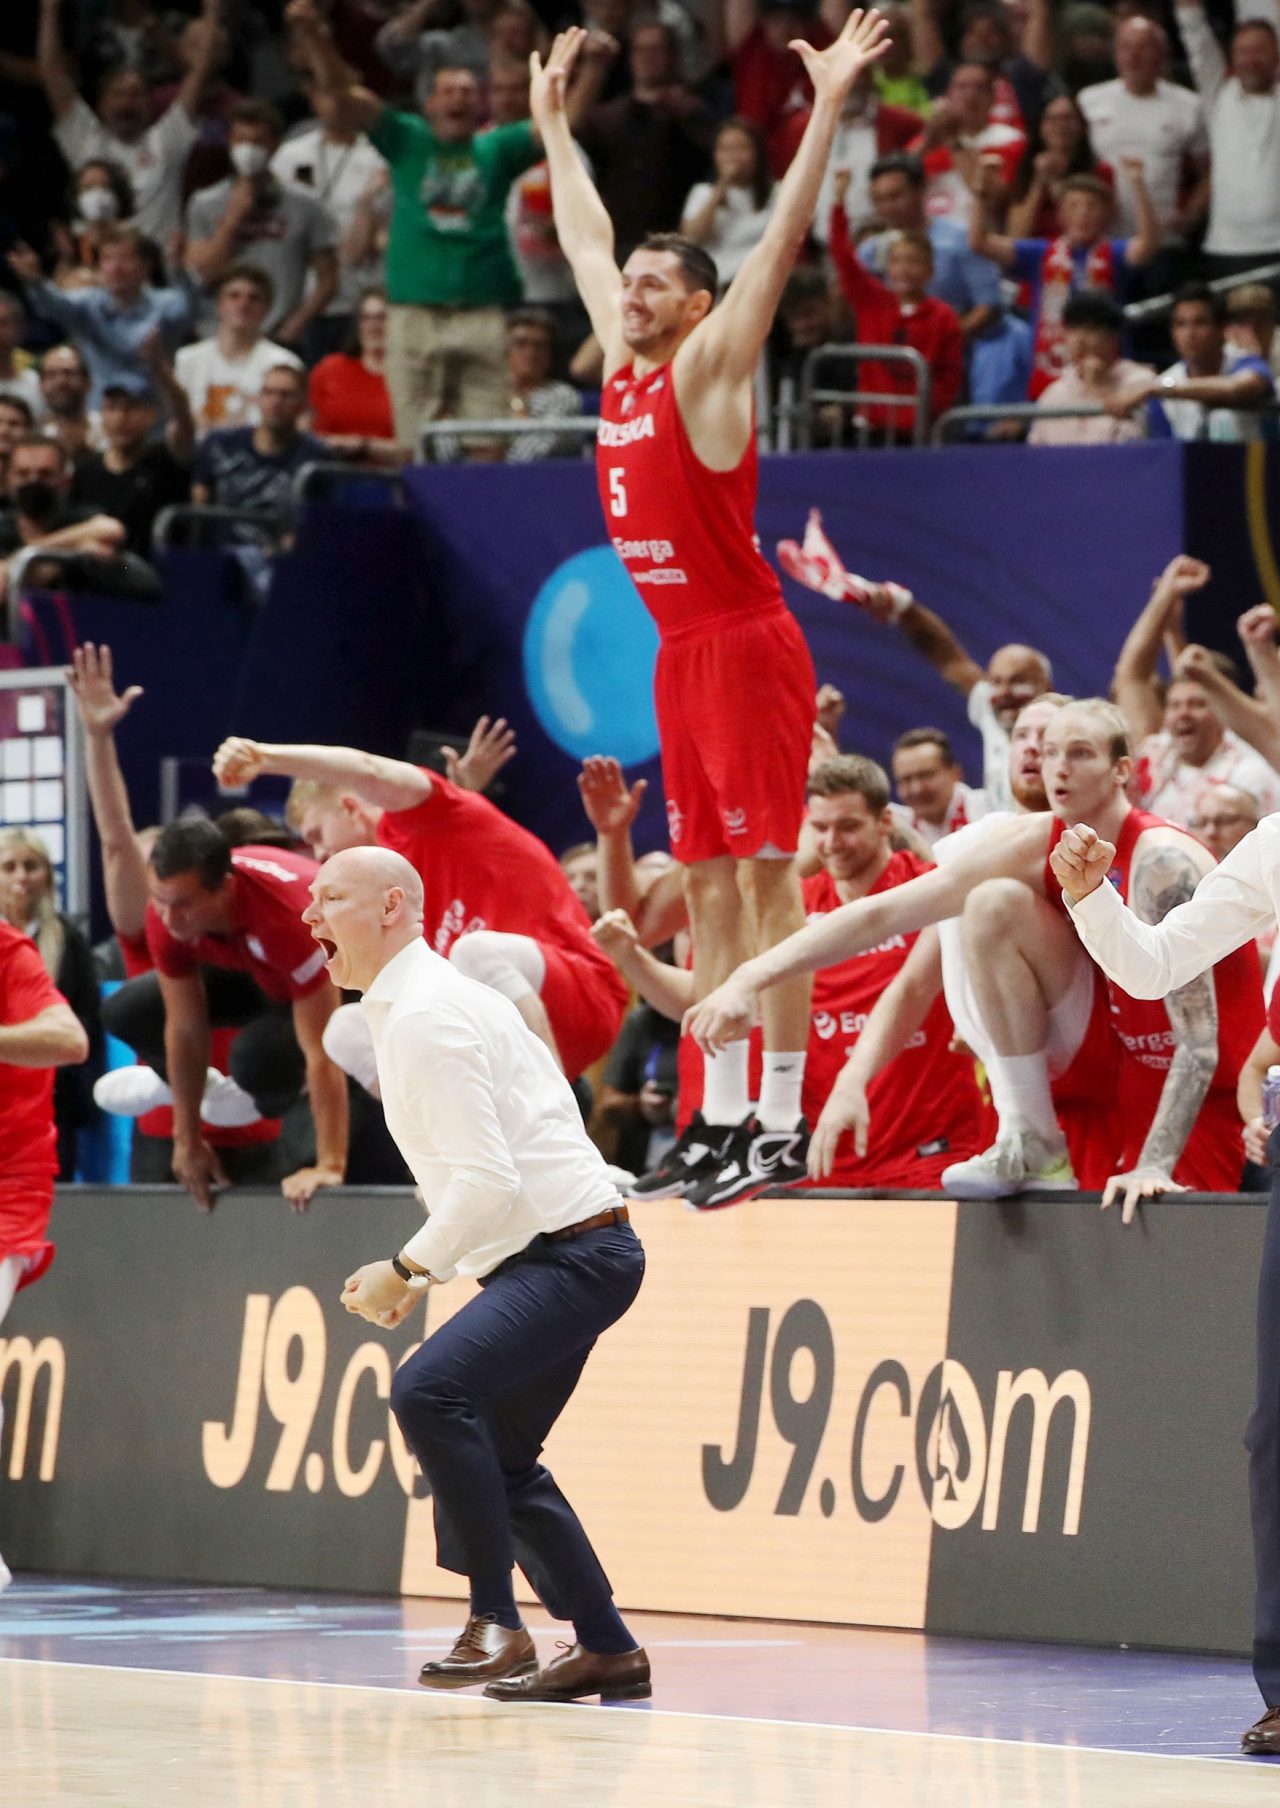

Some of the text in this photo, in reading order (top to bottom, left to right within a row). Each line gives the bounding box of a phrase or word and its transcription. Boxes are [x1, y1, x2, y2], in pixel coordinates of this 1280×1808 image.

[598, 413, 655, 447] OLSKA
[609, 467, 627, 517] 5
[702, 1298, 1091, 1536] J9.com
